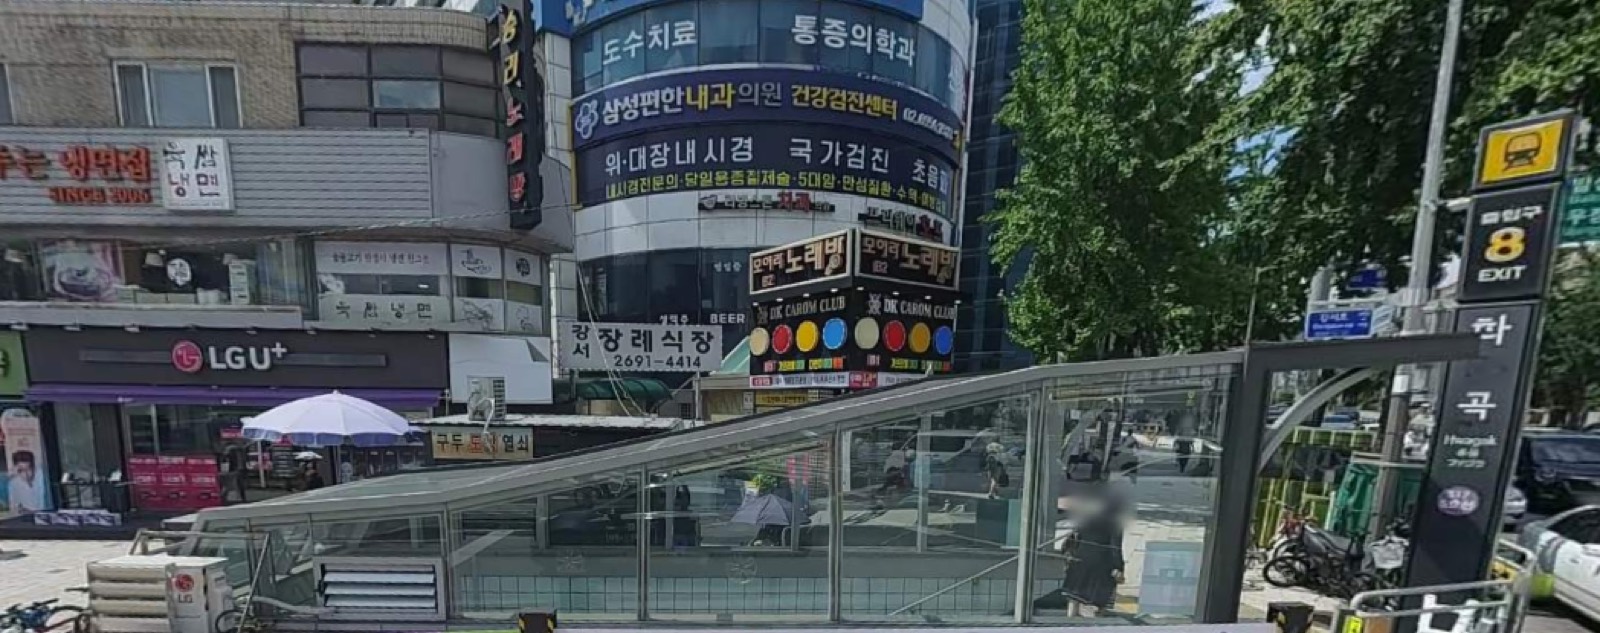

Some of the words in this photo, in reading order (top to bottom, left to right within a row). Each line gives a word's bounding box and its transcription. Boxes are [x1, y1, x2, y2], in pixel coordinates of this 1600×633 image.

[602, 19, 697, 66] 도수치료
[791, 14, 916, 67] 통증의학과
[791, 84, 899, 121] 건강검진센터
[163, 142, 218, 169] 육쌈
[506, 98, 526, 202] 노래방
[789, 138, 889, 174] 국가검진
[169, 173, 220, 197] 냉면
[1484, 227, 1526, 262] 8
[1477, 264, 1526, 282] EXIT
[820, 296, 845, 311] CLUB
[884, 299, 899, 312] DK
[900, 301, 931, 317] CAROM
[710, 313, 745, 324] BEER
[572, 325, 590, 358] 강서
[599, 328, 714, 354] 장례식장
[614, 355, 701, 367] 2691-4414
[437, 434, 463, 453] 구두
[503, 434, 528, 453] 열쇠
